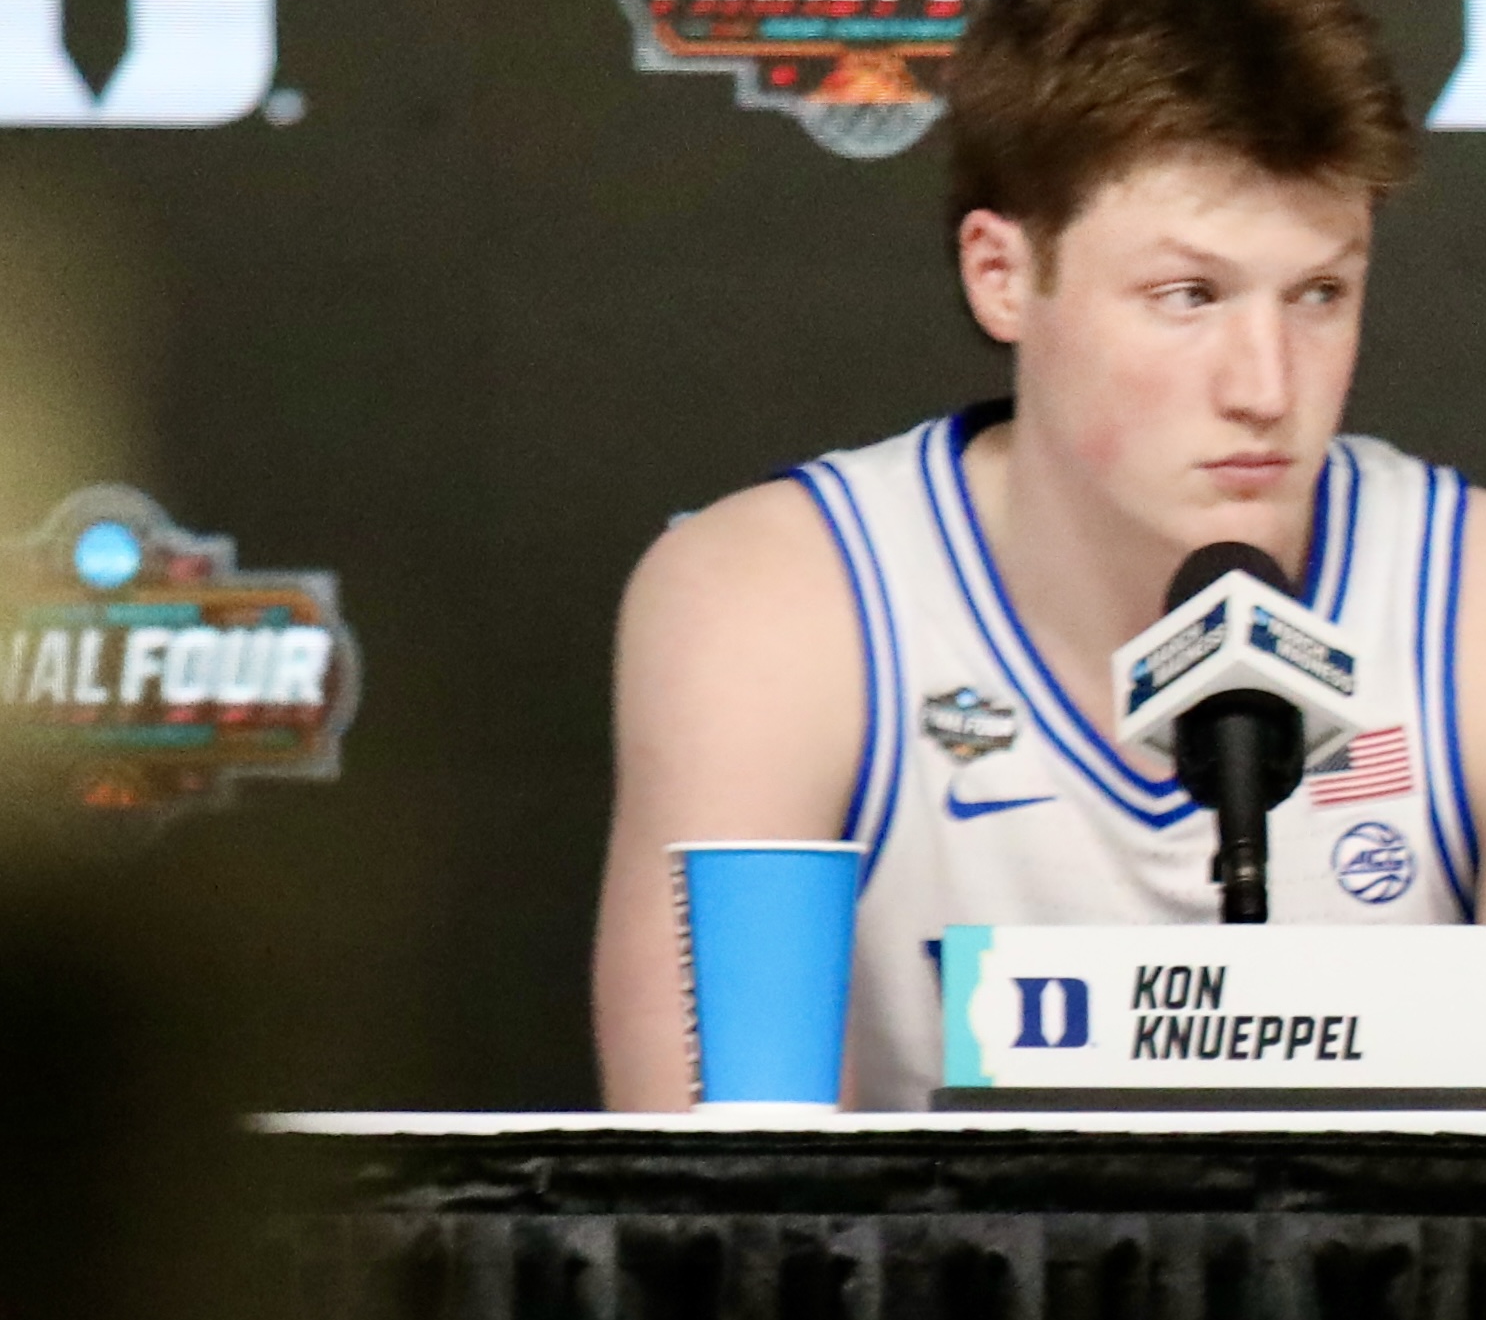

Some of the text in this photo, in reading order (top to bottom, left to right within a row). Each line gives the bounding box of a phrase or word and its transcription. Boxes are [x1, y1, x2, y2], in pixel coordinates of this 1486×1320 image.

[119, 626, 333, 706] FOUR
[1010, 977, 1090, 1049] D
[1131, 965, 1227, 1010] KON
[1131, 1015, 1364, 1061] KNUEPPEL
